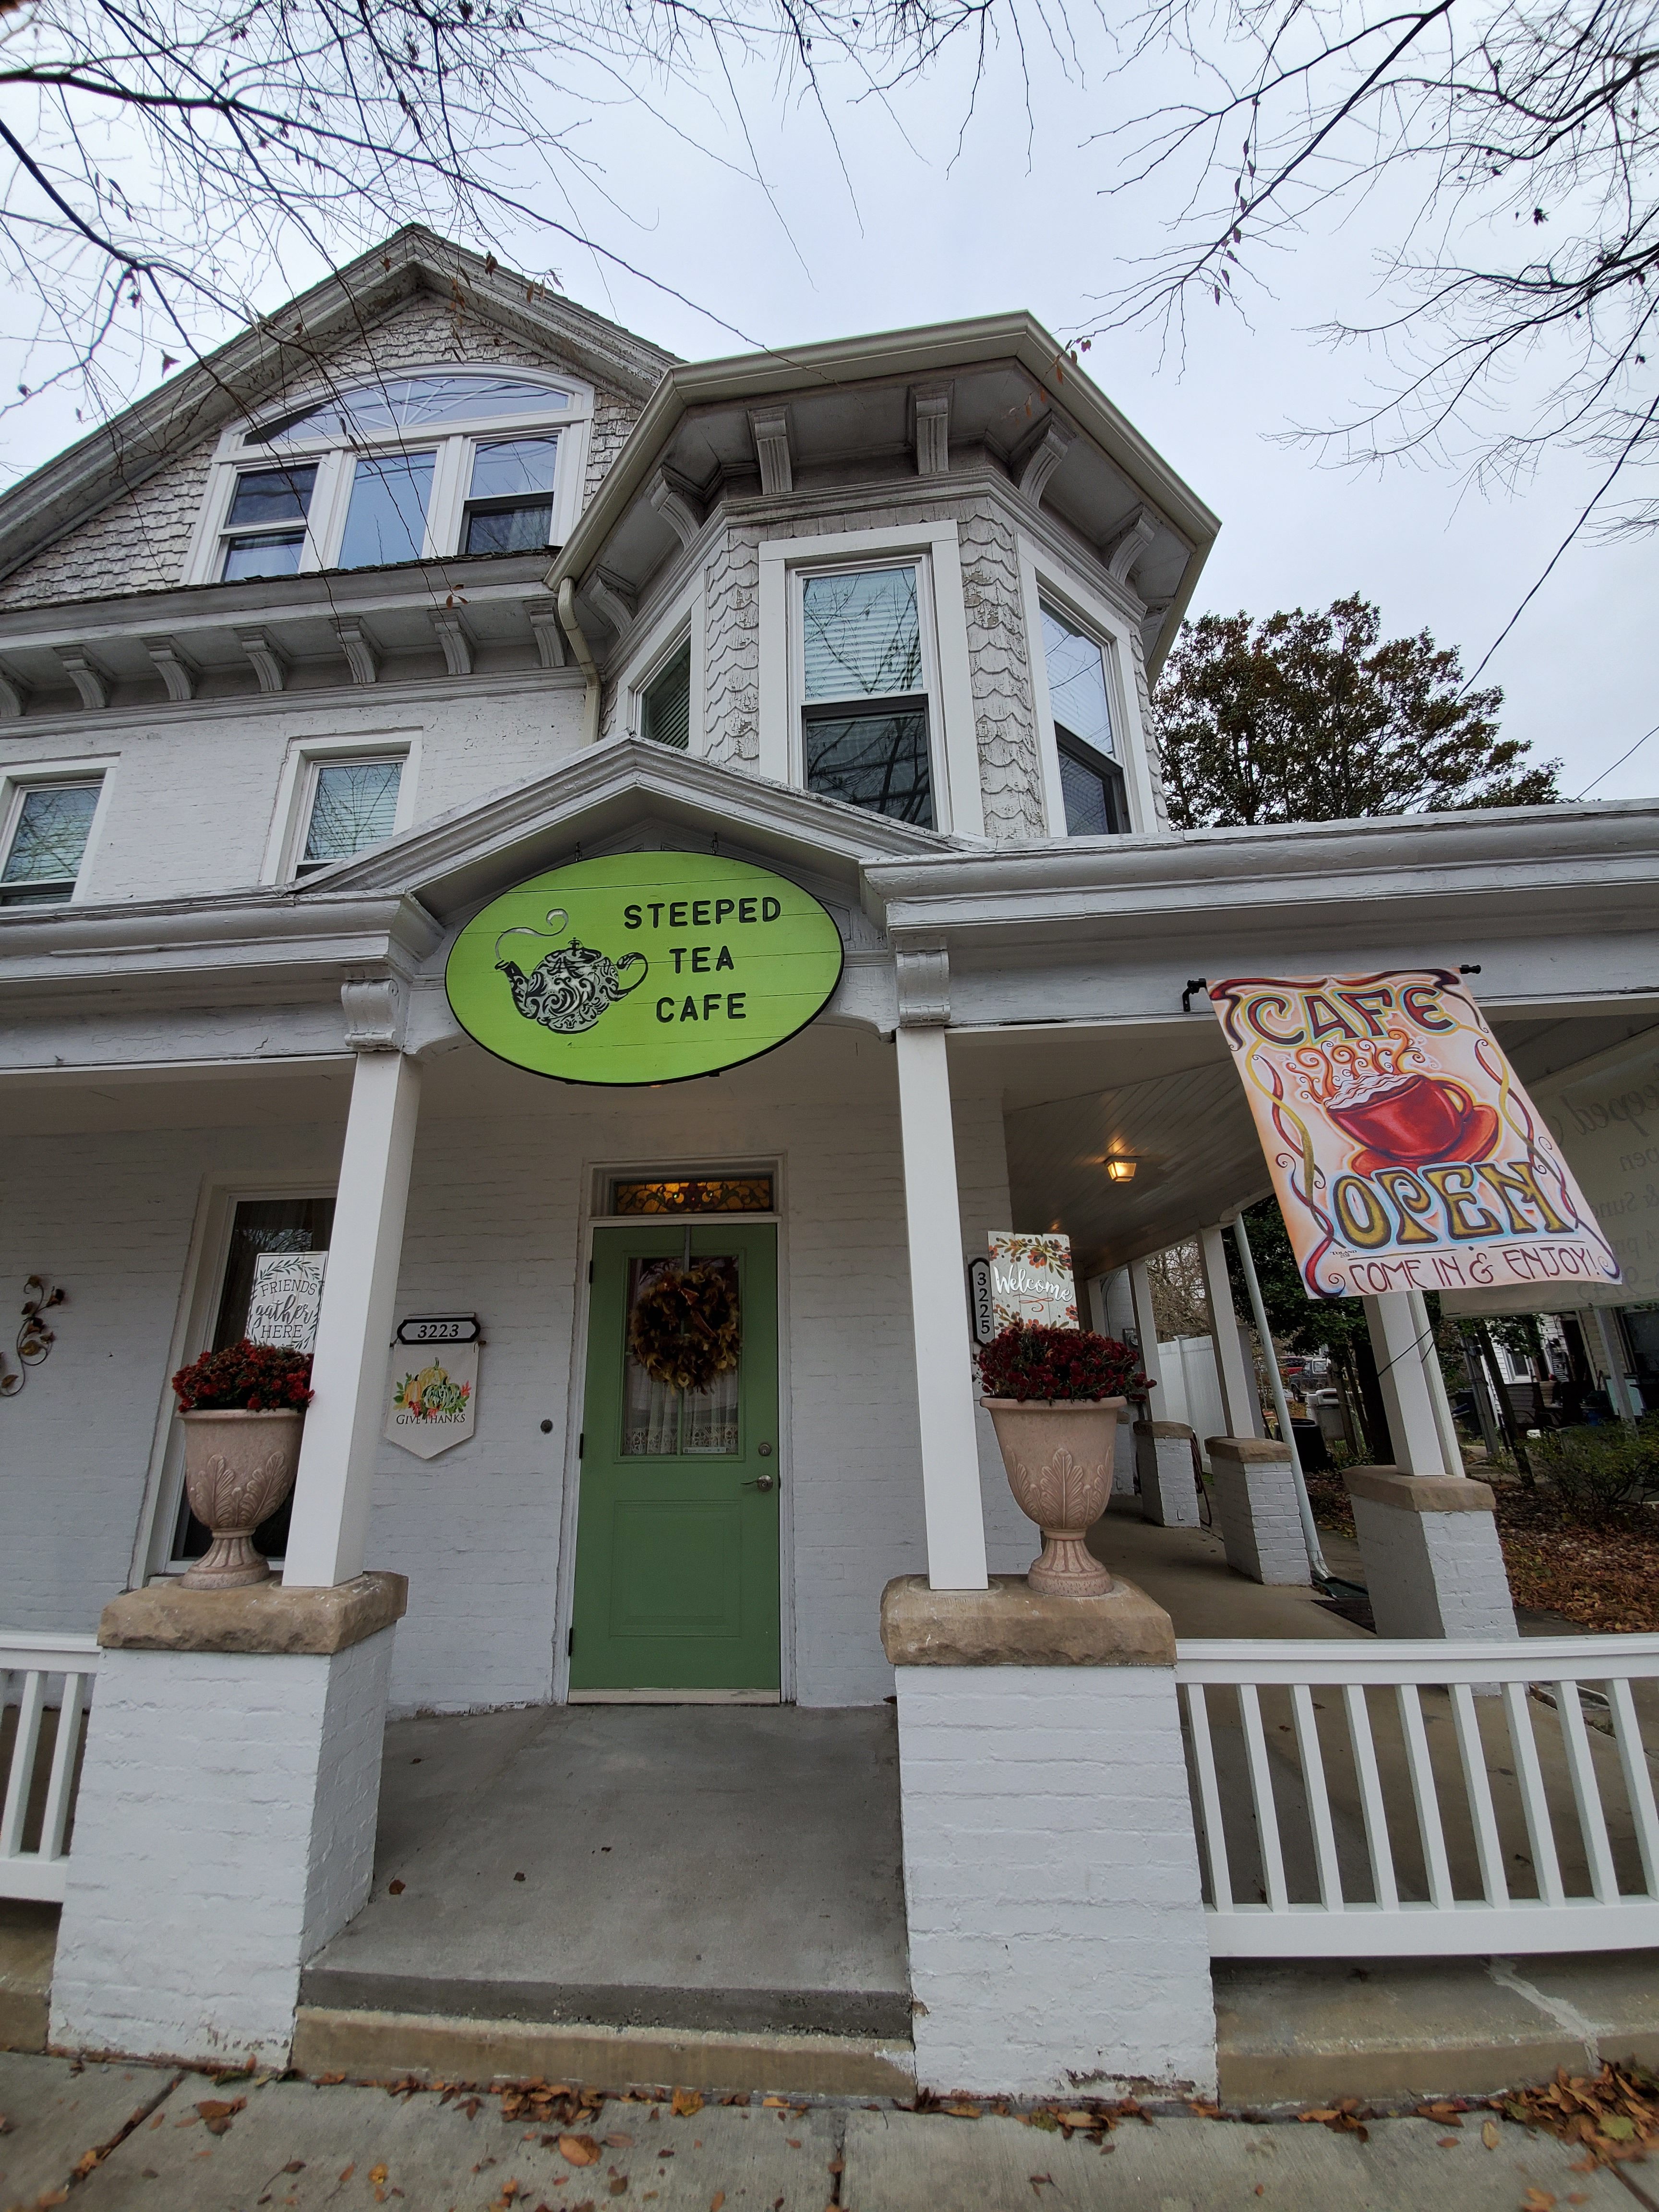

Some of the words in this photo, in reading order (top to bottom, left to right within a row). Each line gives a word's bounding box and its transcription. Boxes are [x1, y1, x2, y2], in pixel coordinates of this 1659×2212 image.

[624, 896, 781, 929] STEEPED
[669, 945, 734, 974] TEA
[657, 992, 746, 1023] CAFE
[1247, 986, 1458, 1046] CAFE
[1332, 1162, 1575, 1250] OPEN
[993, 1264, 1073, 1302] Welcome
[1348, 1259, 1428, 1294] COME
[1431, 1256, 1466, 1286] IN
[1469, 1253, 1493, 1284] &
[1502, 1247, 1600, 1279] ENJOY!
[261, 1279, 317, 1297] FRIENDS
[977, 1272, 990, 1334] 3225
[253, 1294, 313, 1328] gather
[261, 1325, 303, 1338] HERE
[418, 1323, 459, 1338] 3223
[396, 1415, 421, 1424] GIVE
